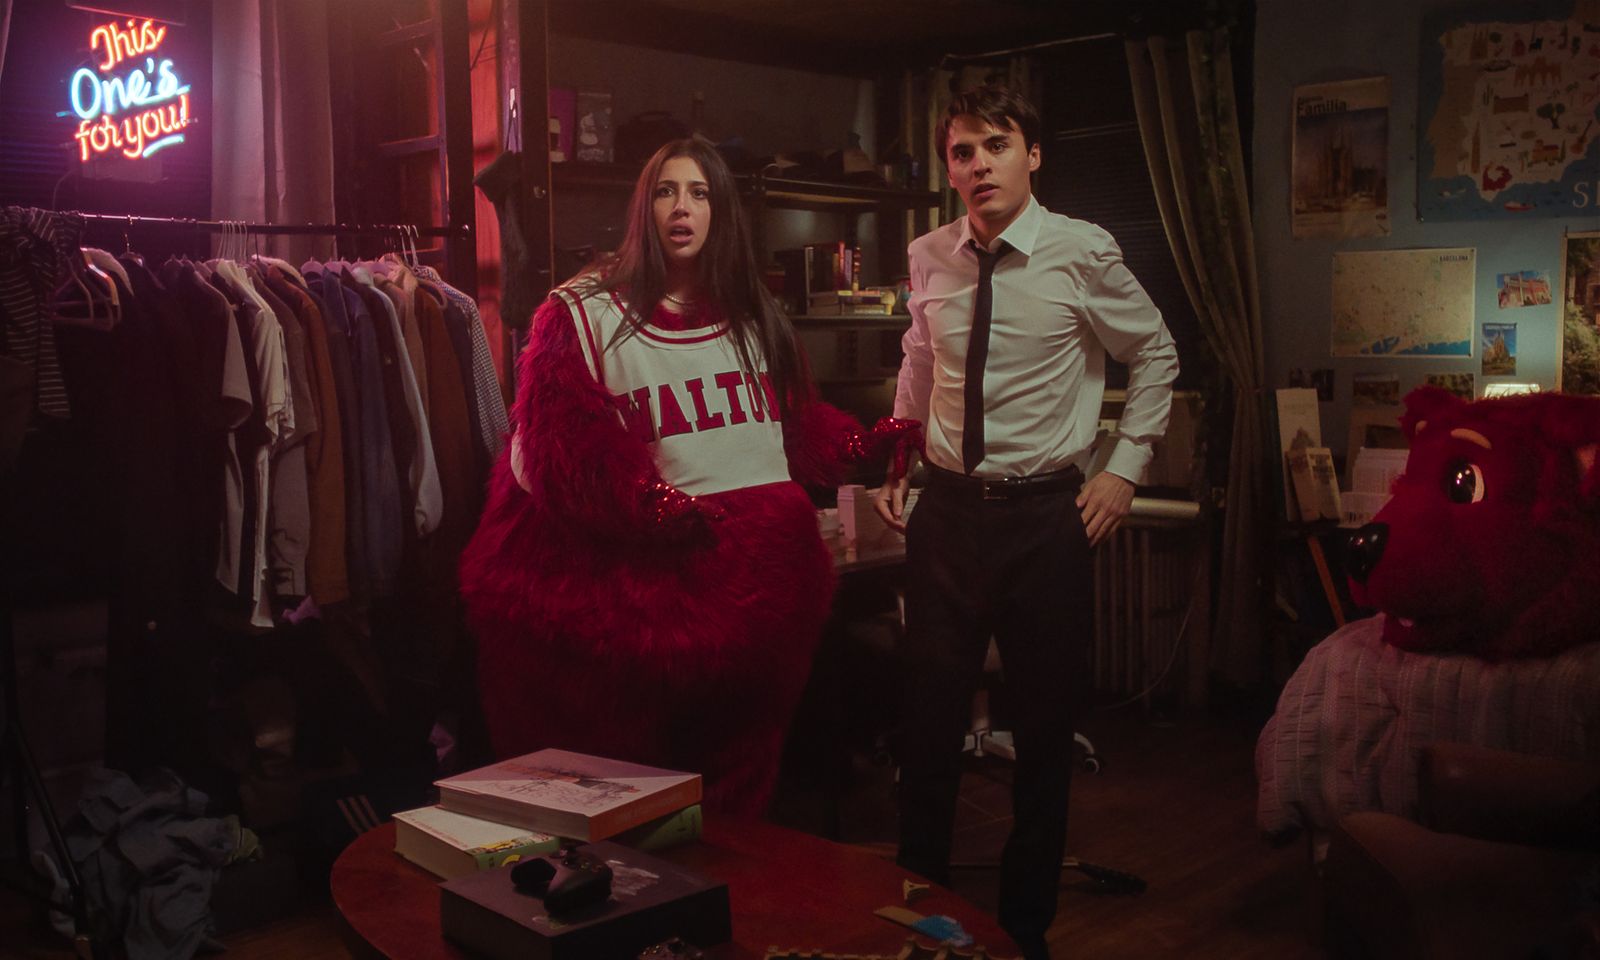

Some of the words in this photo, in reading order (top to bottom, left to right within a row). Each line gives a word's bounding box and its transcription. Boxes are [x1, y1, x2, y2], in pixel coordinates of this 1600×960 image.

[90, 18, 166, 70] This
[69, 57, 187, 119] One's
[75, 114, 122, 161] for
[122, 94, 189, 158] you!
